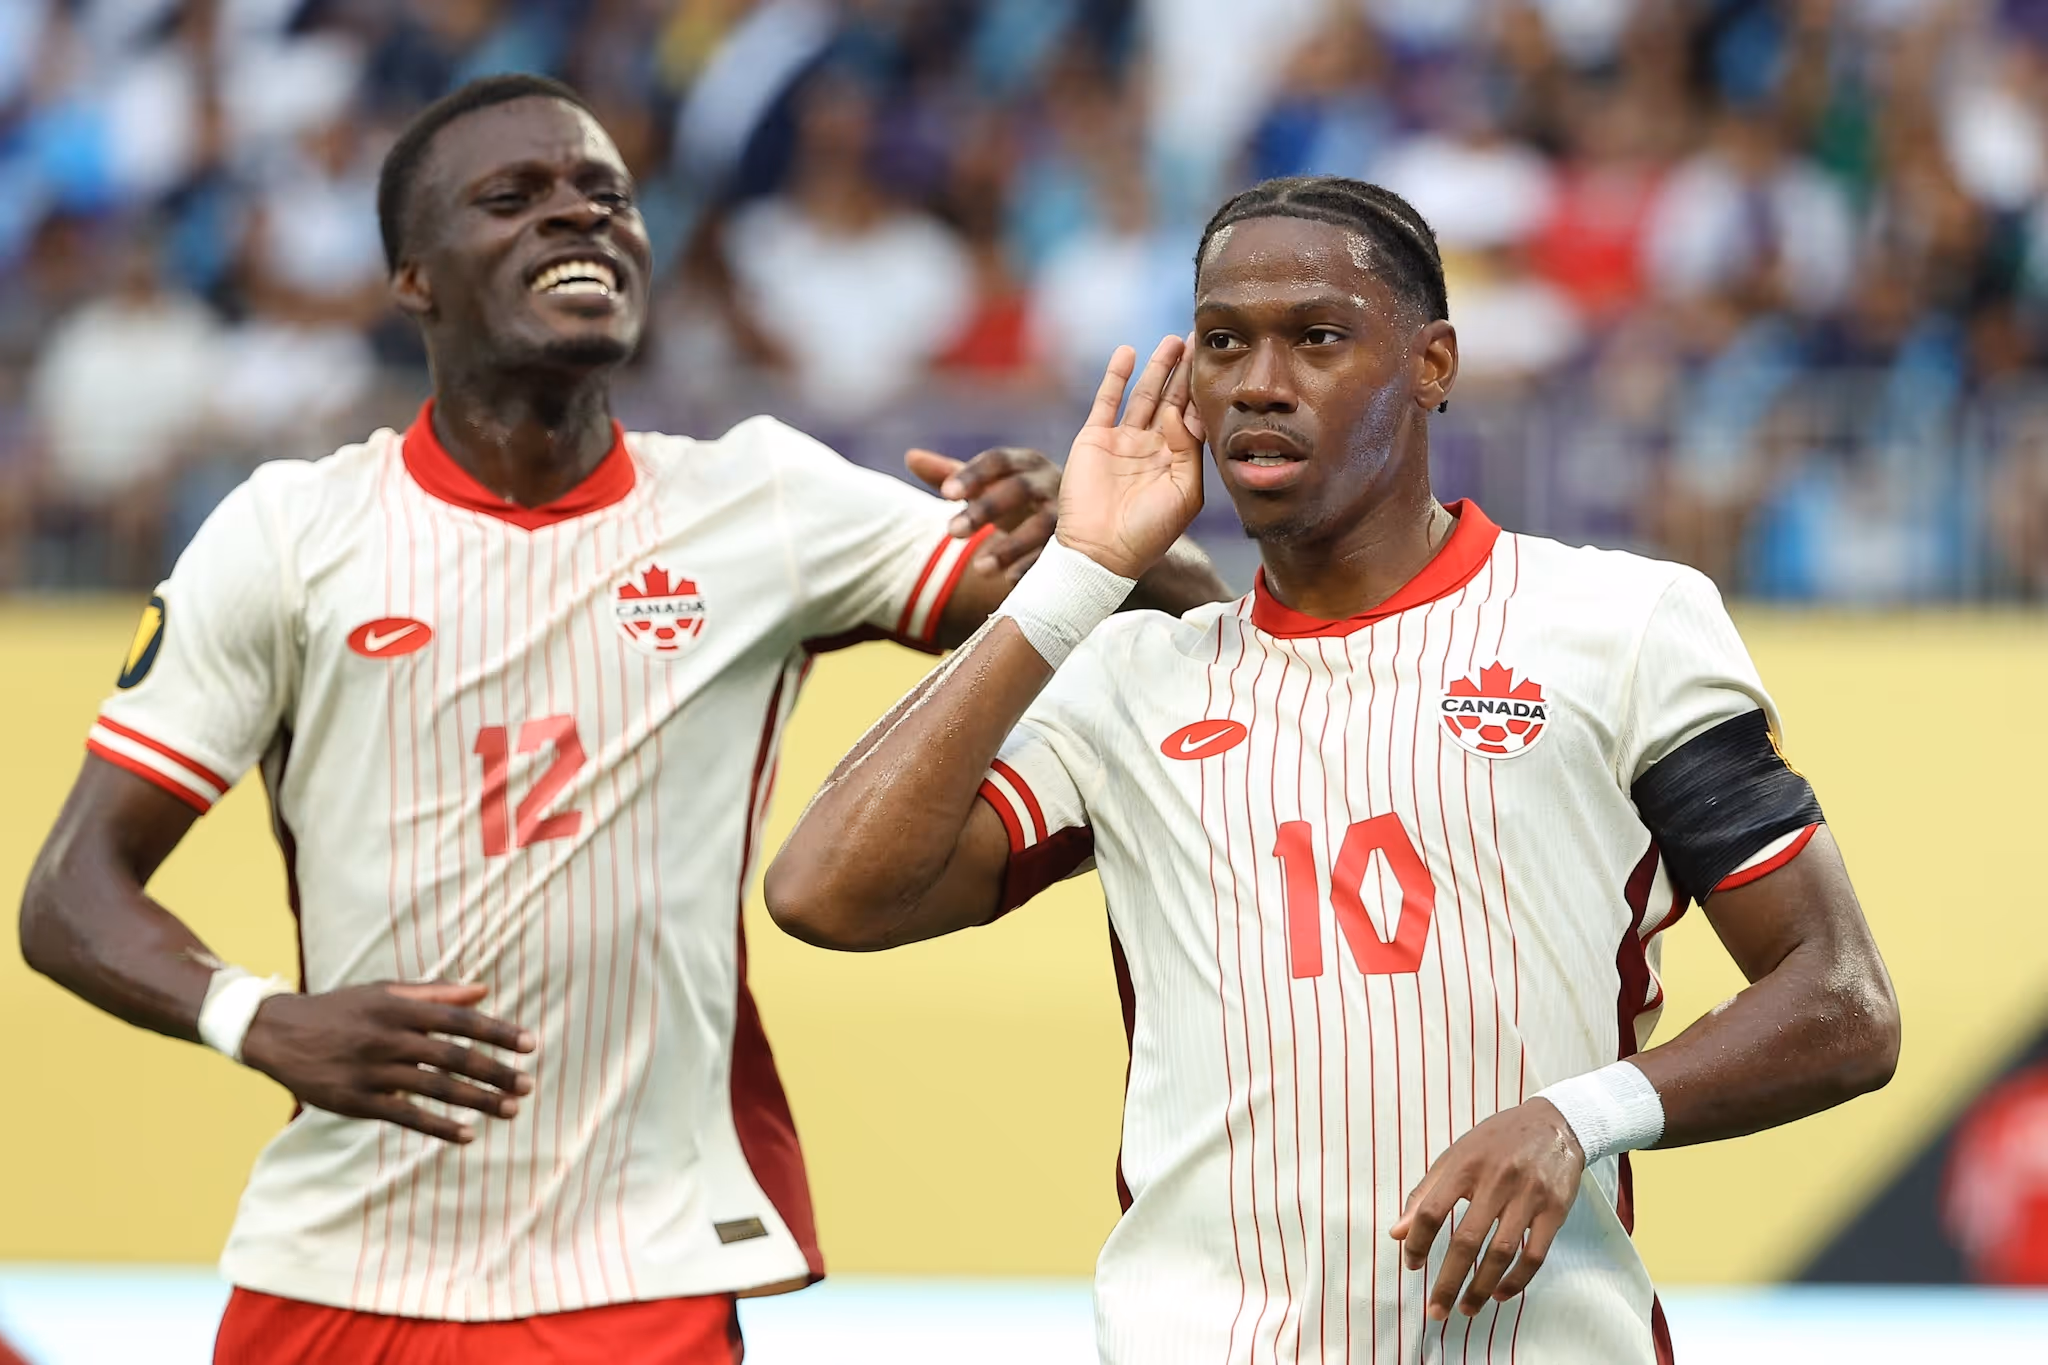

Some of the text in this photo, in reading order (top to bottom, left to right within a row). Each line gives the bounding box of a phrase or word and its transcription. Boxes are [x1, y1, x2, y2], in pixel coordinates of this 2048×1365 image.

[616, 600, 705, 616] CANADA
[1441, 699, 1546, 720] CANADA
[473, 714, 587, 857] 12
[1272, 812, 1436, 979] 10
